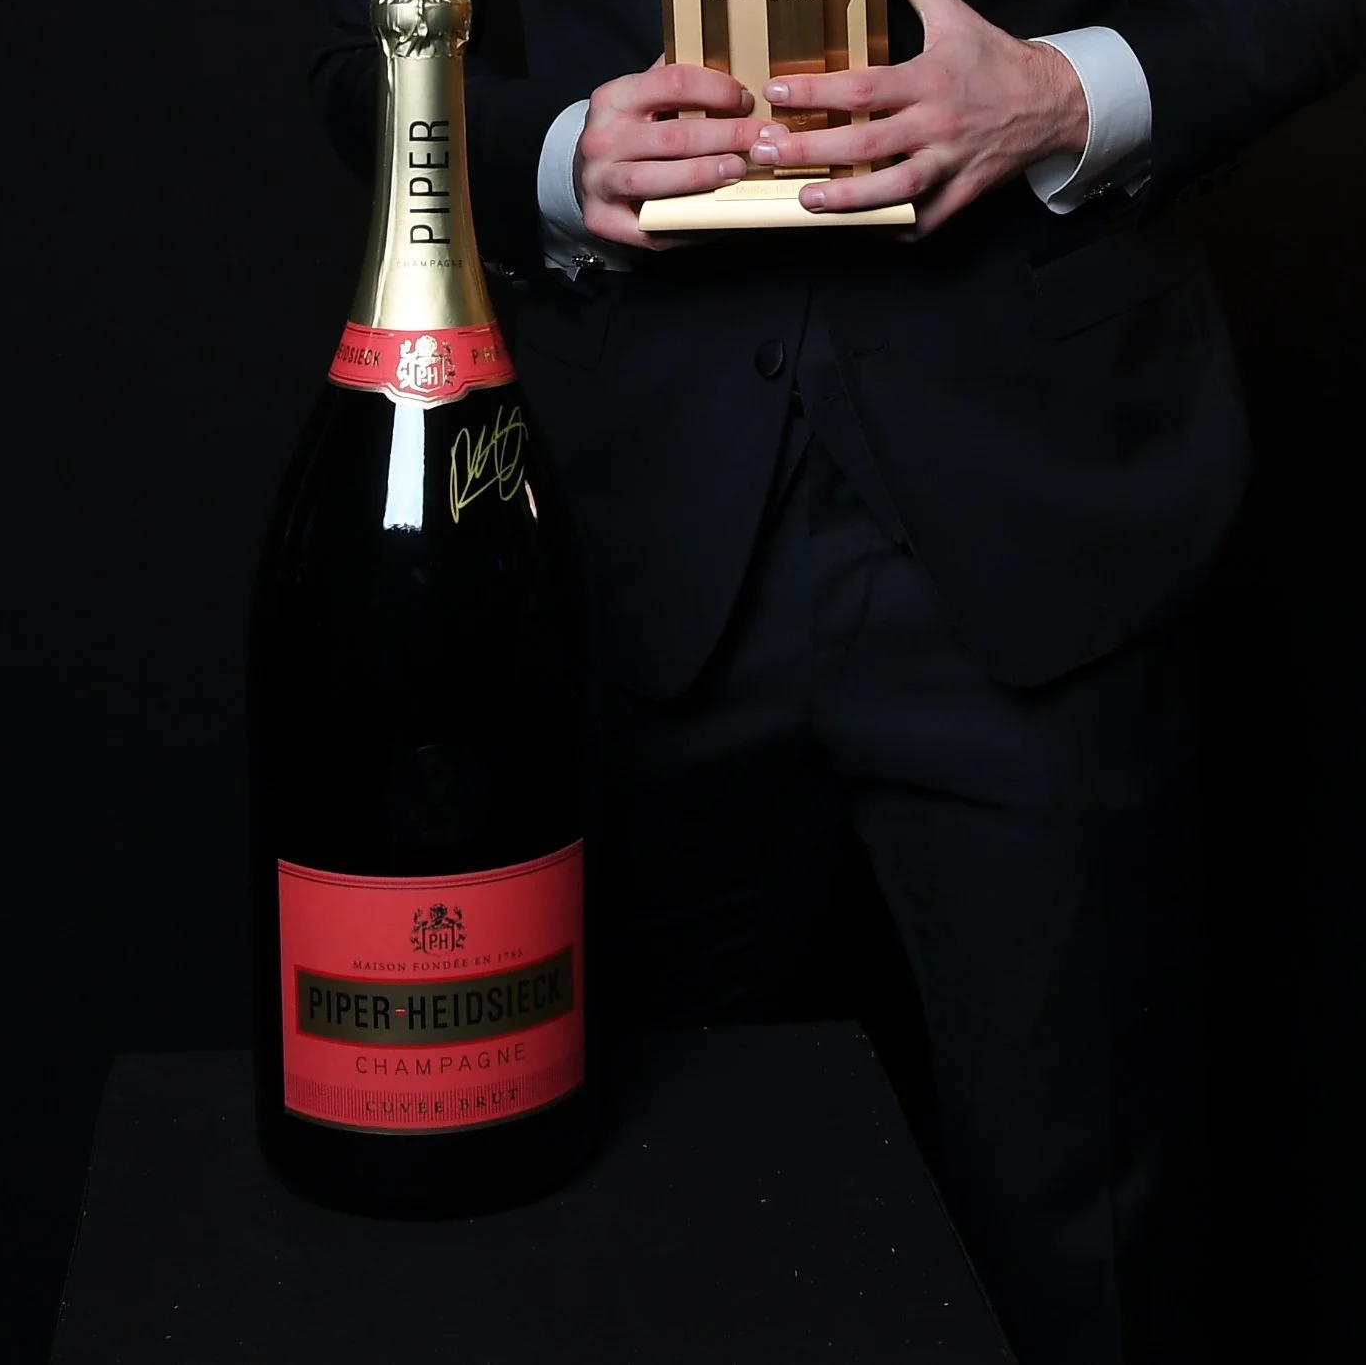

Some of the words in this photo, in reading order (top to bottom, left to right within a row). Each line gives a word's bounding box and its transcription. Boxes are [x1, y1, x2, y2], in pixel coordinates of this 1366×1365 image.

[409, 119, 451, 246] PIPER
[352, 959, 406, 972] MAISON
[412, 957, 469, 971] FONDÉE
[474, 954, 491, 966] EN
[355, 1042, 525, 1076] CHAMPAGNE
[459, 1088, 519, 1112] BRUT
